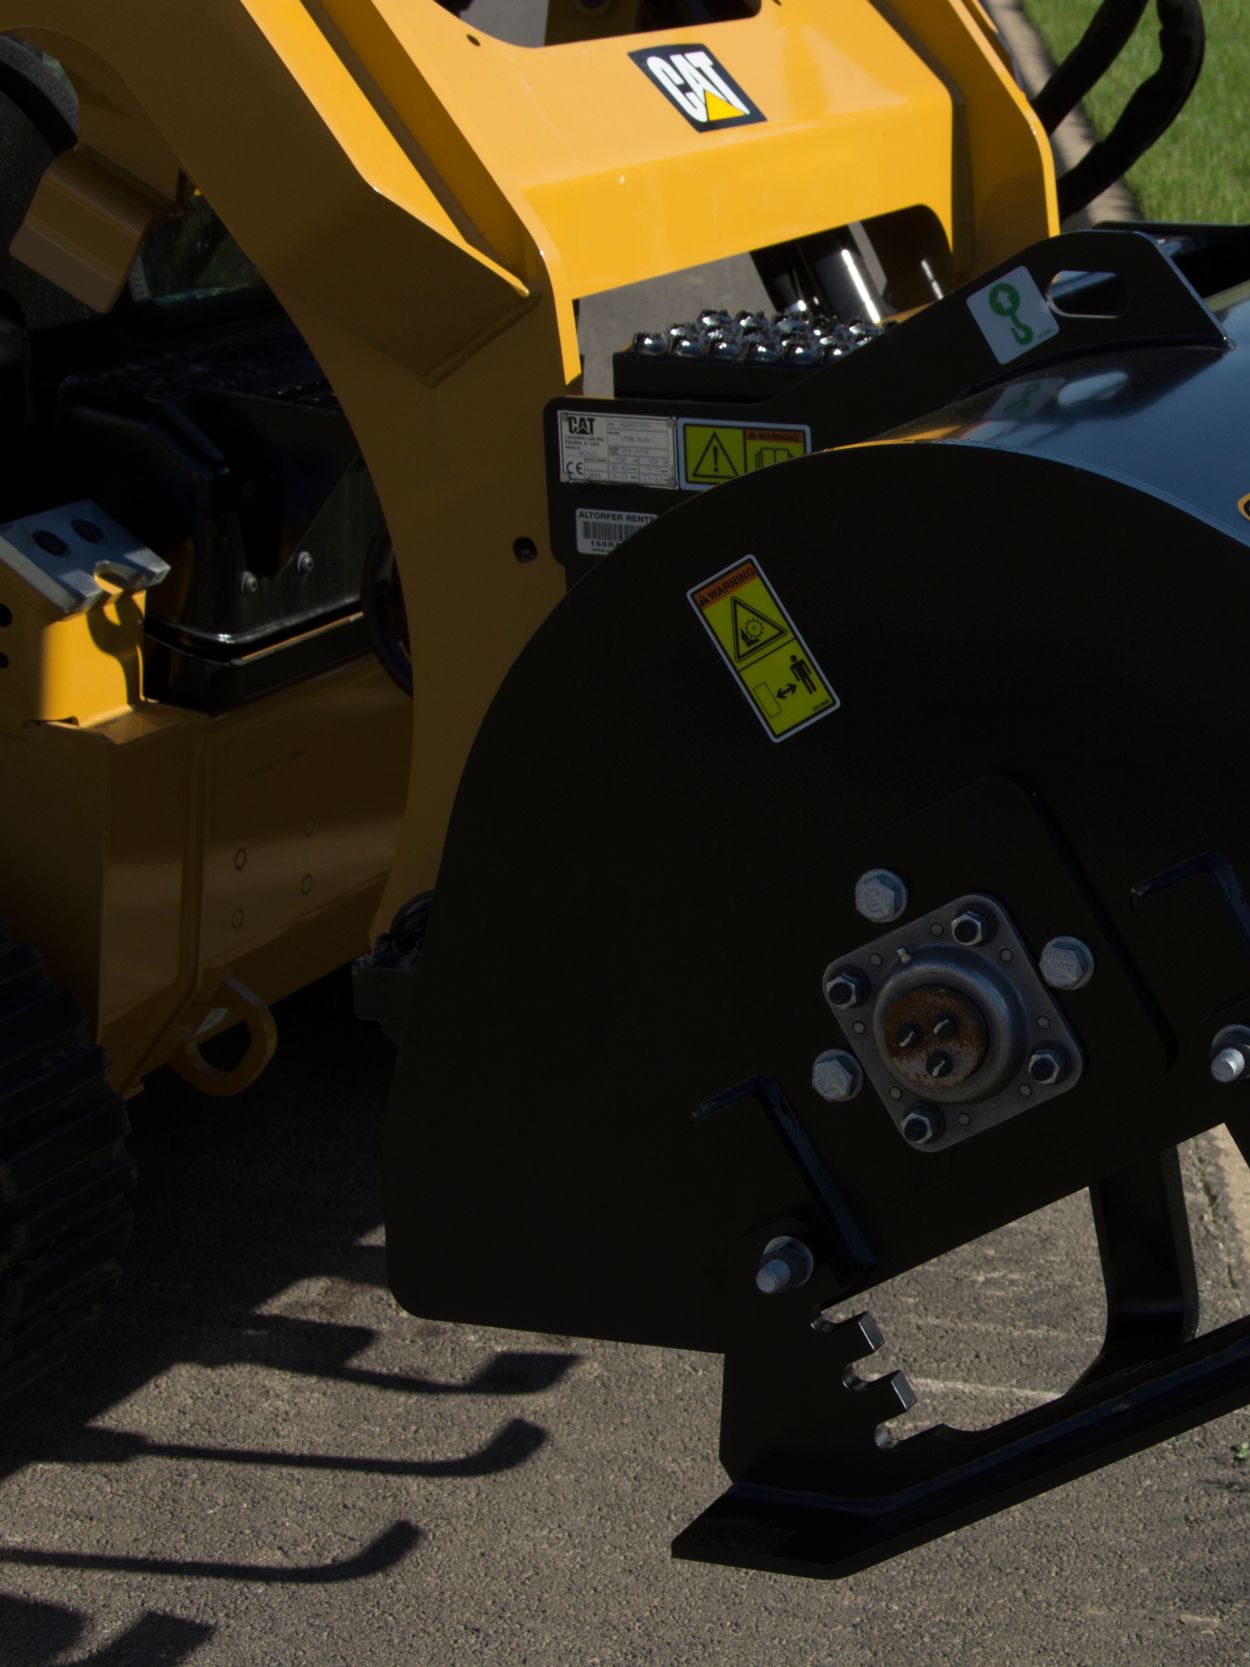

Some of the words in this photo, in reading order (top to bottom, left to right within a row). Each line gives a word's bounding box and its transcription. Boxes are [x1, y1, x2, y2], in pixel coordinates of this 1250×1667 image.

[646, 51, 750, 122] CAT
[568, 416, 595, 435] CAT
[757, 431, 800, 443] WARNING
[579, 511, 623, 521] ALTORFER
[707, 567, 756, 601] WARNING
